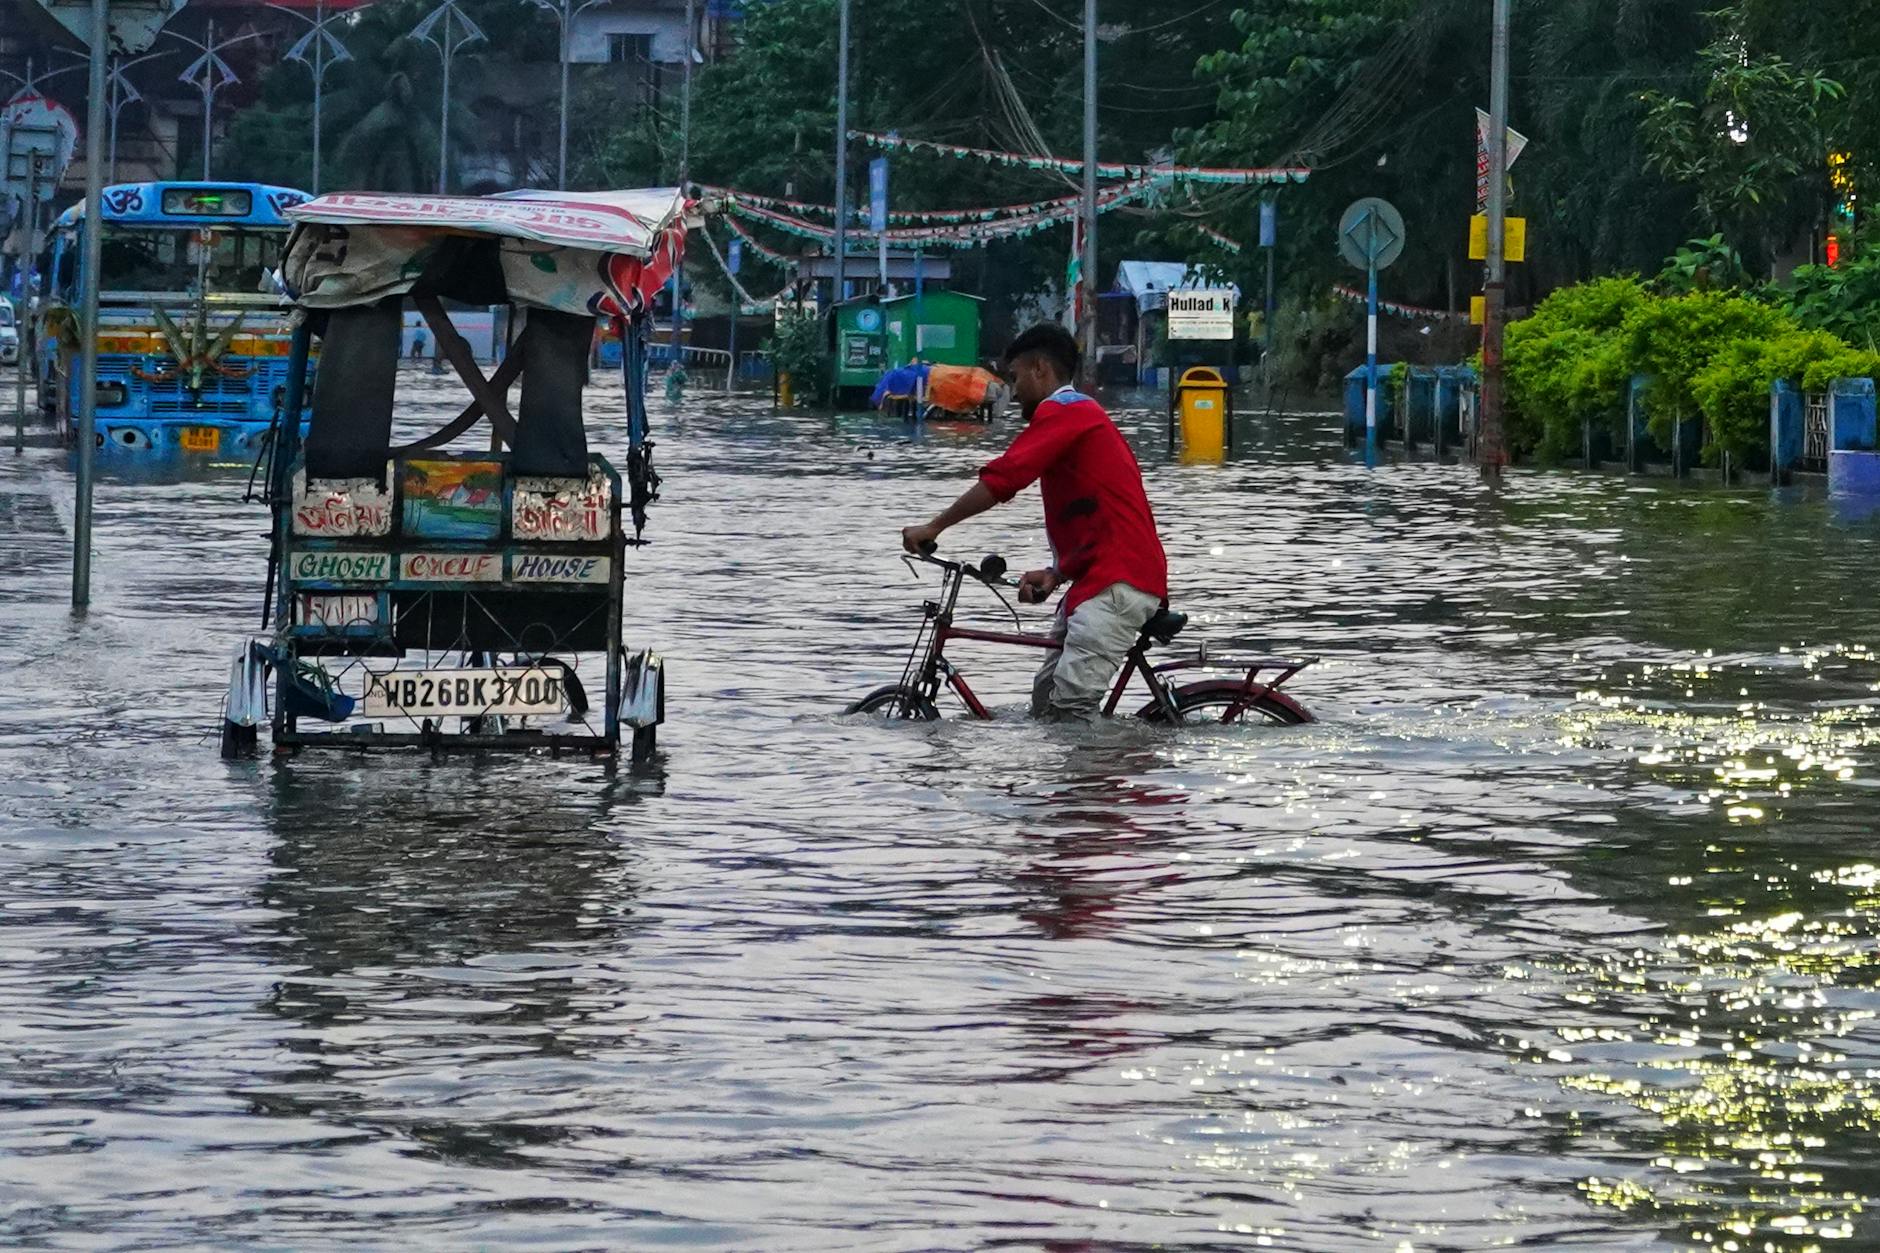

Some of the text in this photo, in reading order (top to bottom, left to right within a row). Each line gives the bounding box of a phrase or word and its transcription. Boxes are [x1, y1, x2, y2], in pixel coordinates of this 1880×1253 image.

[297, 553, 386, 578] GHOSH
[518, 556, 600, 578] HOUSE
[385, 678, 558, 707] WB26BK3700
